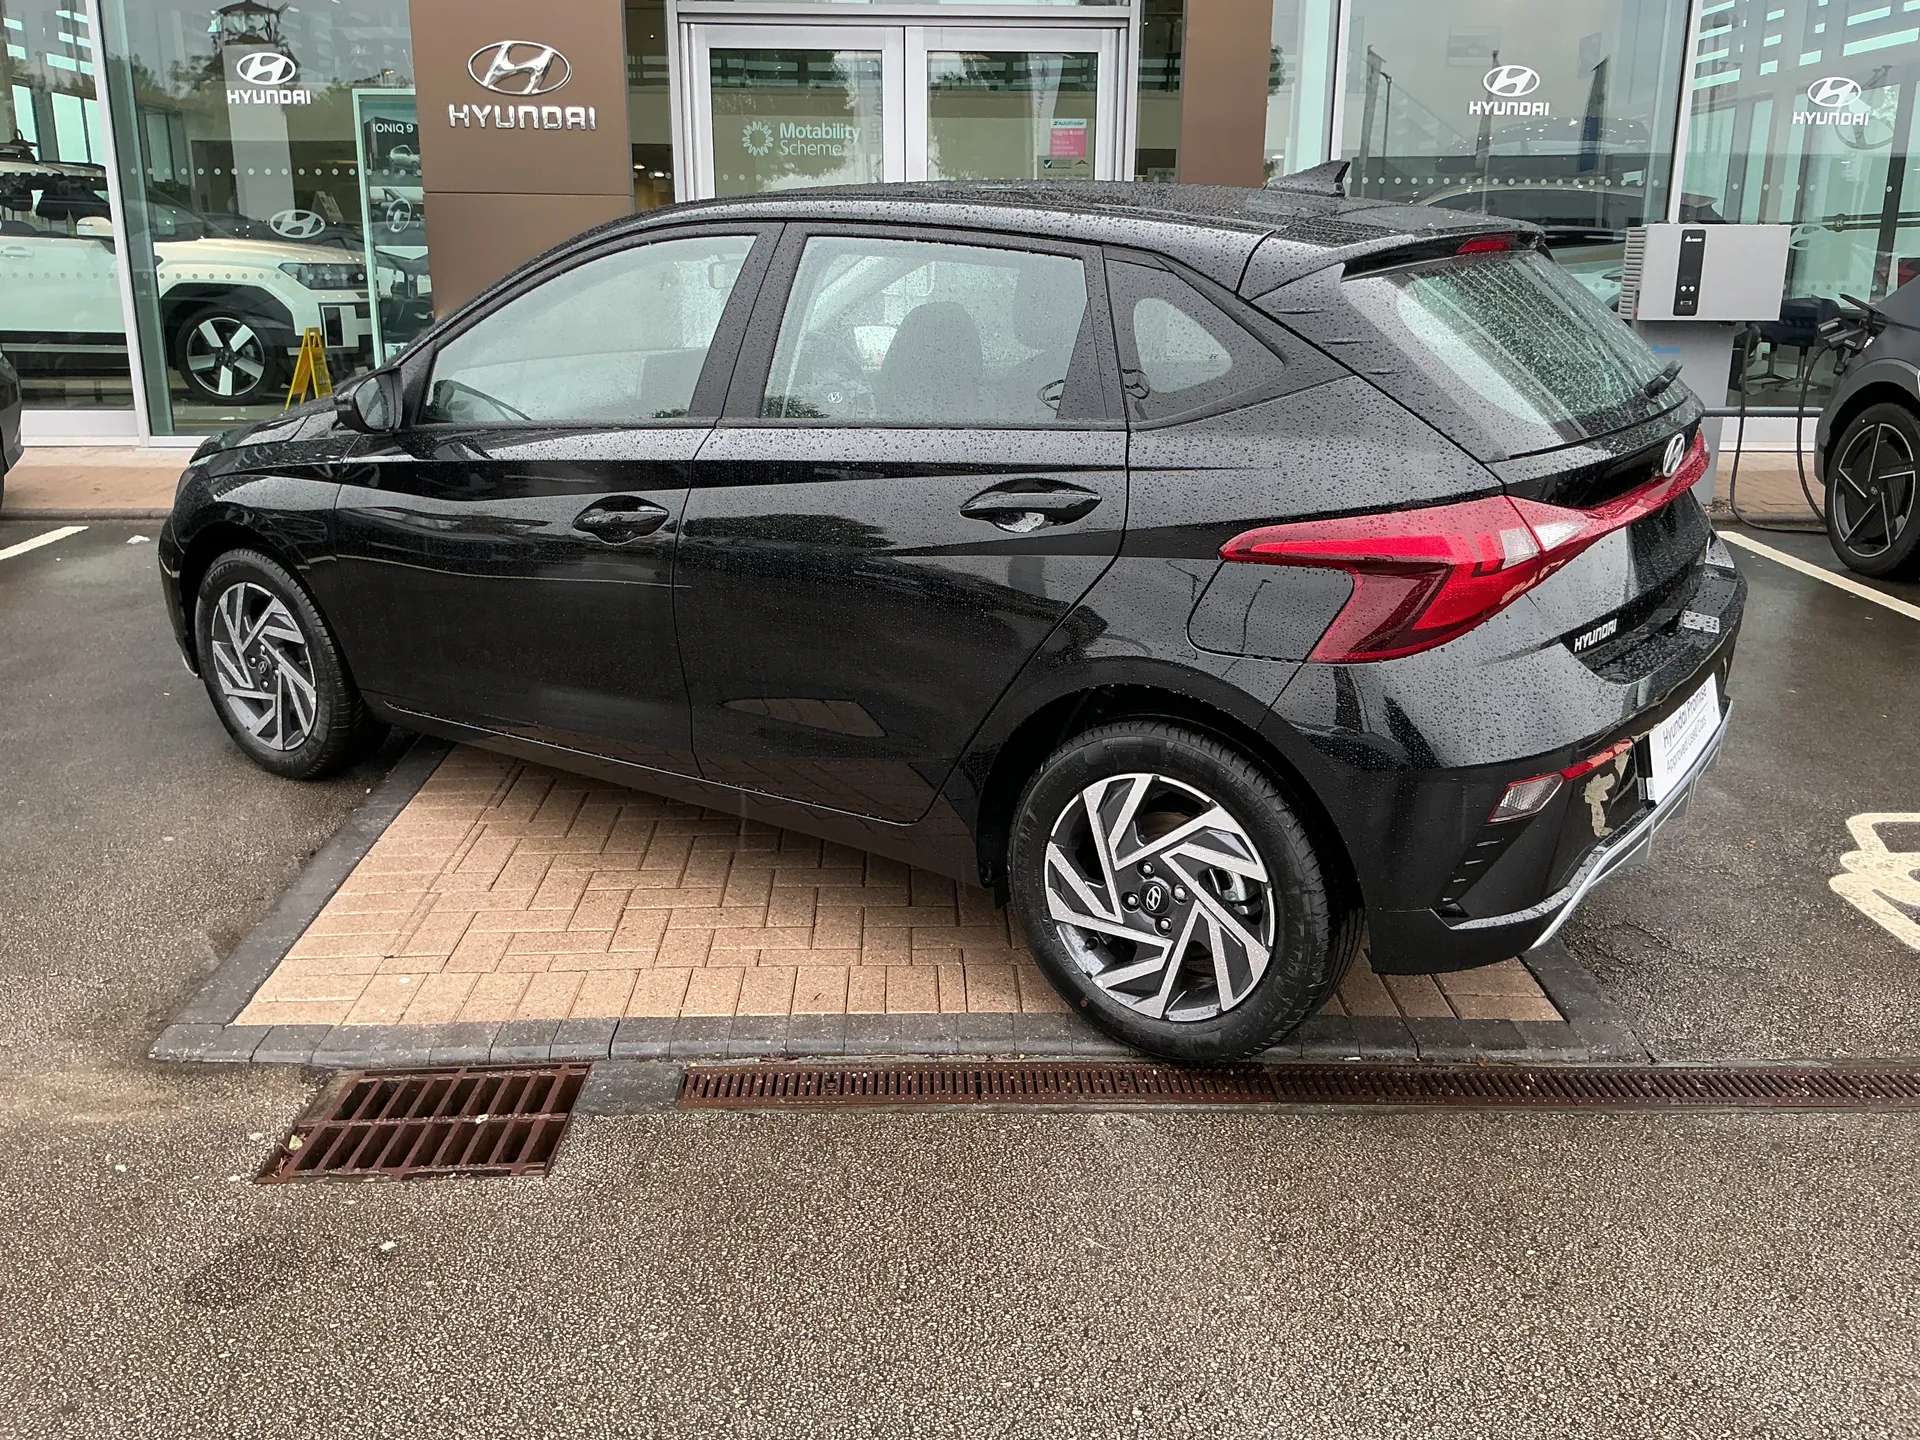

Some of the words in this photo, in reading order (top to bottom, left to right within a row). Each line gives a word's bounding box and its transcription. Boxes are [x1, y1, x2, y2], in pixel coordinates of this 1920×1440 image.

[227, 89, 311, 104] HYUNDAI
[448, 104, 596, 129] HYUNDAI
[1469, 101, 1550, 116] HYUNDAI
[1793, 112, 1869, 125] HYUNDAI
[371, 123, 404, 134] IONIQ
[406, 123, 414, 133] 9
[779, 122, 861, 144] Motability
[779, 140, 842, 156] Scheme
[1574, 618, 1617, 652] HYUNDAI
[1662, 711, 1687, 749] Hyundai
[1686, 685, 1708, 716] Promise
